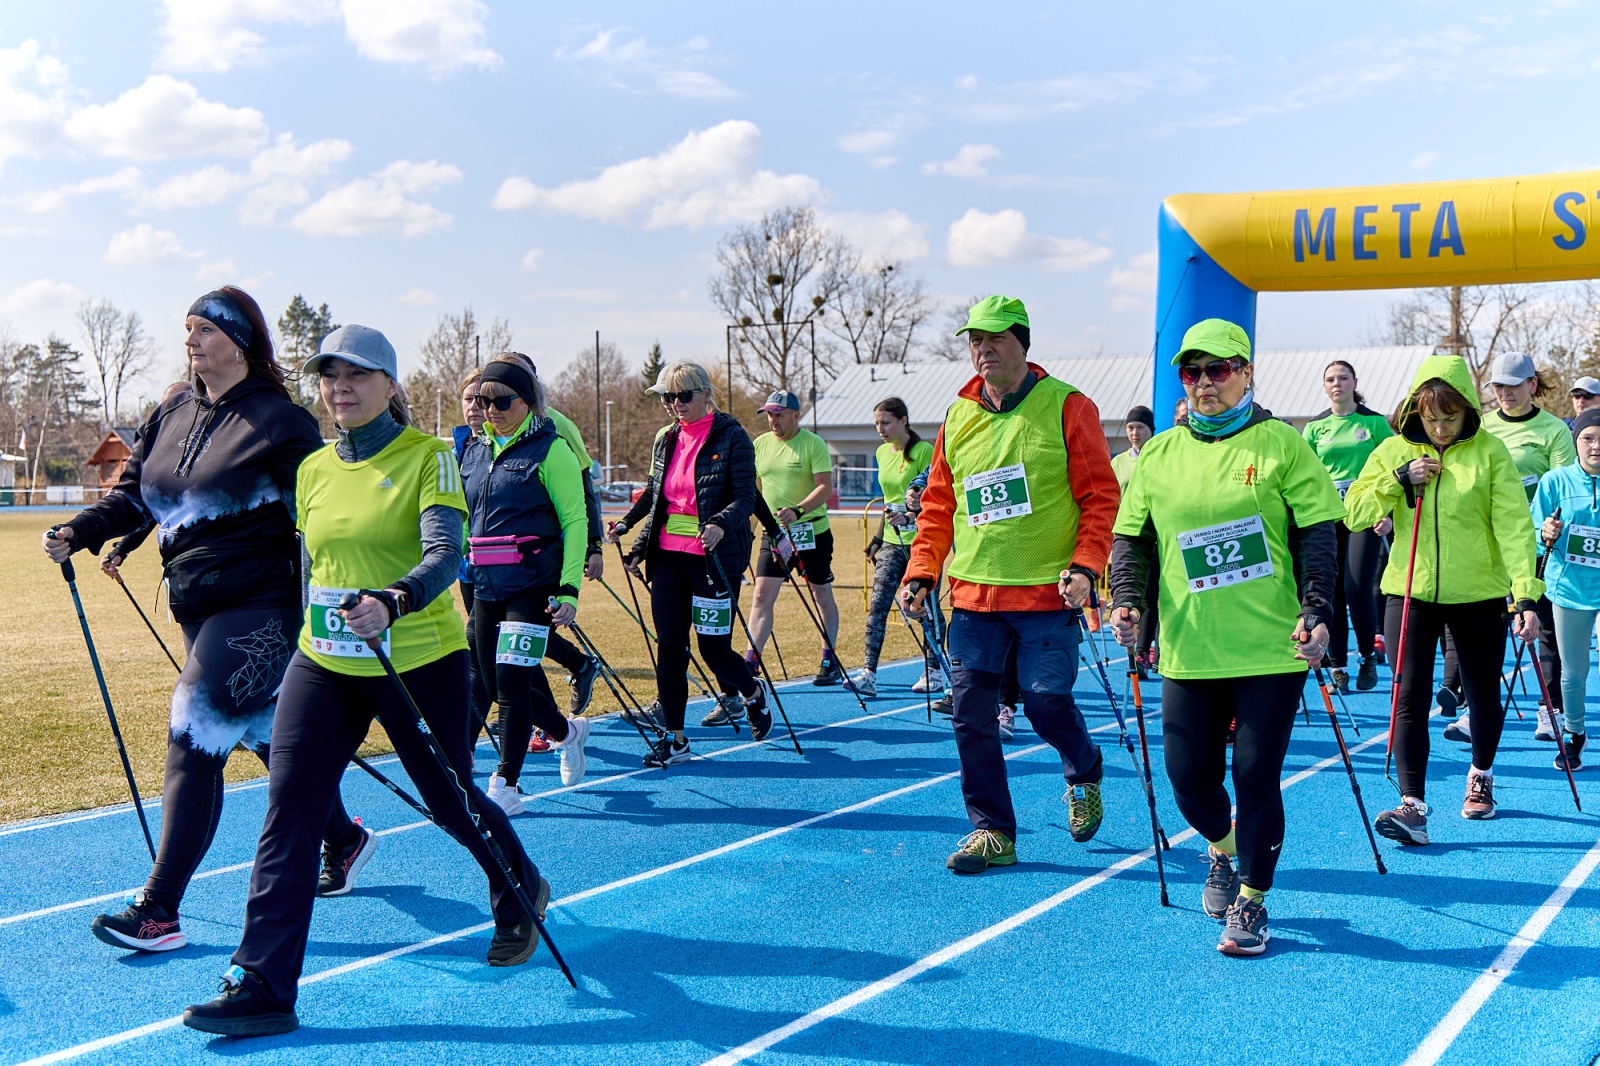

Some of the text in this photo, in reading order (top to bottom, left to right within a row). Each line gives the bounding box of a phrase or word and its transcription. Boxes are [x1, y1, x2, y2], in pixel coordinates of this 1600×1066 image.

[1293, 191, 1600, 262] META S
[980, 483, 1008, 505] 83
[1203, 533, 1225, 541] SZUKAMY
[1225, 527, 1248, 537] BOCIANA
[1214, 525, 1233, 535] NORDIC
[1233, 519, 1256, 529] WALKING
[791, 531, 808, 542] 22
[1204, 540, 1244, 567] 82
[1216, 562, 1241, 574] ANNA
[700, 608, 719, 623] 52
[508, 634, 532, 652] 16
